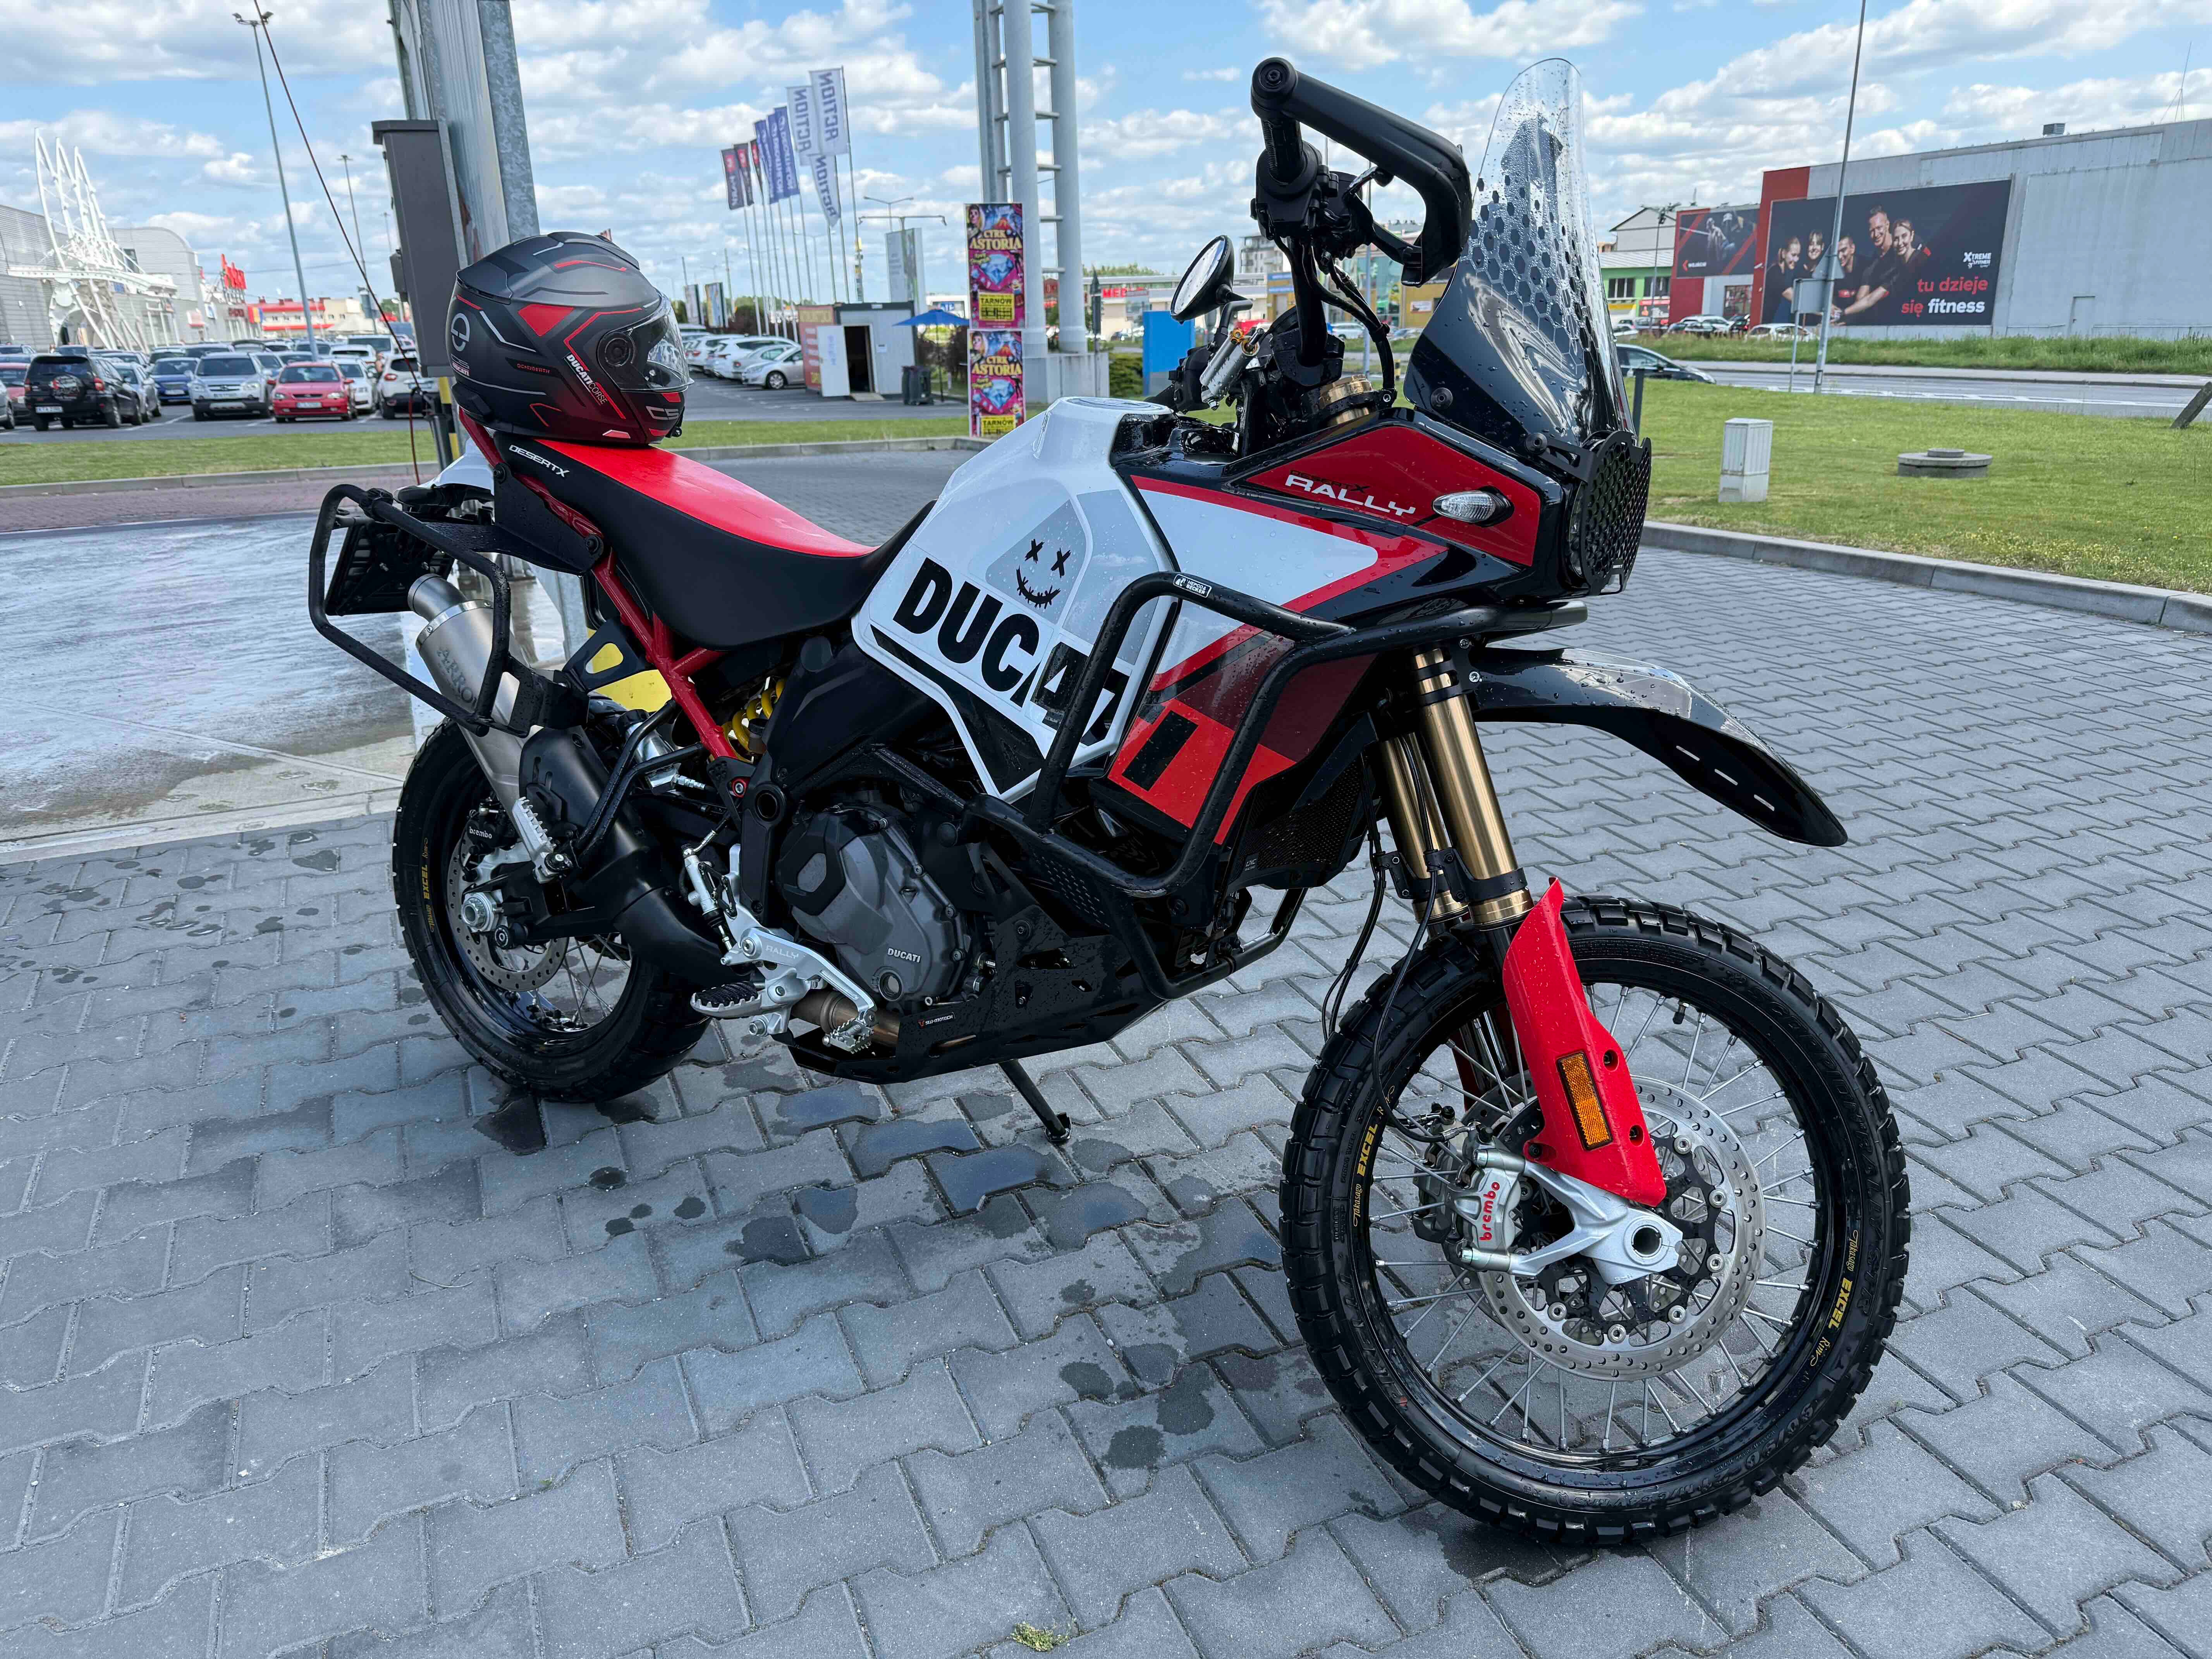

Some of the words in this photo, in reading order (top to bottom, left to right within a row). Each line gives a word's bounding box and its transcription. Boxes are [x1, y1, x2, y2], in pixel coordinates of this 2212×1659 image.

[969, 237, 1023, 250] ASTORIA
[1963, 252, 1991, 262] XTREME
[1917, 278, 1930, 292] tu
[1939, 276, 1988, 295] dzieje
[1902, 299, 1924, 318] się
[1928, 298, 1985, 313] fitness
[971, 363, 1023, 376] ASTORIA
[1285, 474, 1416, 516] RALLY
[1186, 584, 1205, 594] BECKER
[437, 647, 477, 707] ARRO
[469, 826, 492, 839] brembo
[421, 865, 430, 899] EXCEL
[765, 945, 799, 959] RALLY
[887, 948, 921, 963] DUCATI
[1357, 1124, 1378, 1177] EXCEL
[1353, 1183, 1363, 1227] Takasago
[1479, 1182, 1500, 1241] brembo
[1846, 1229, 1859, 1272] Takasago
[1855, 1245, 1881, 1315] STR
[1828, 1277, 1853, 1331] EXCEL
[1810, 1336, 1830, 1366] Rim
